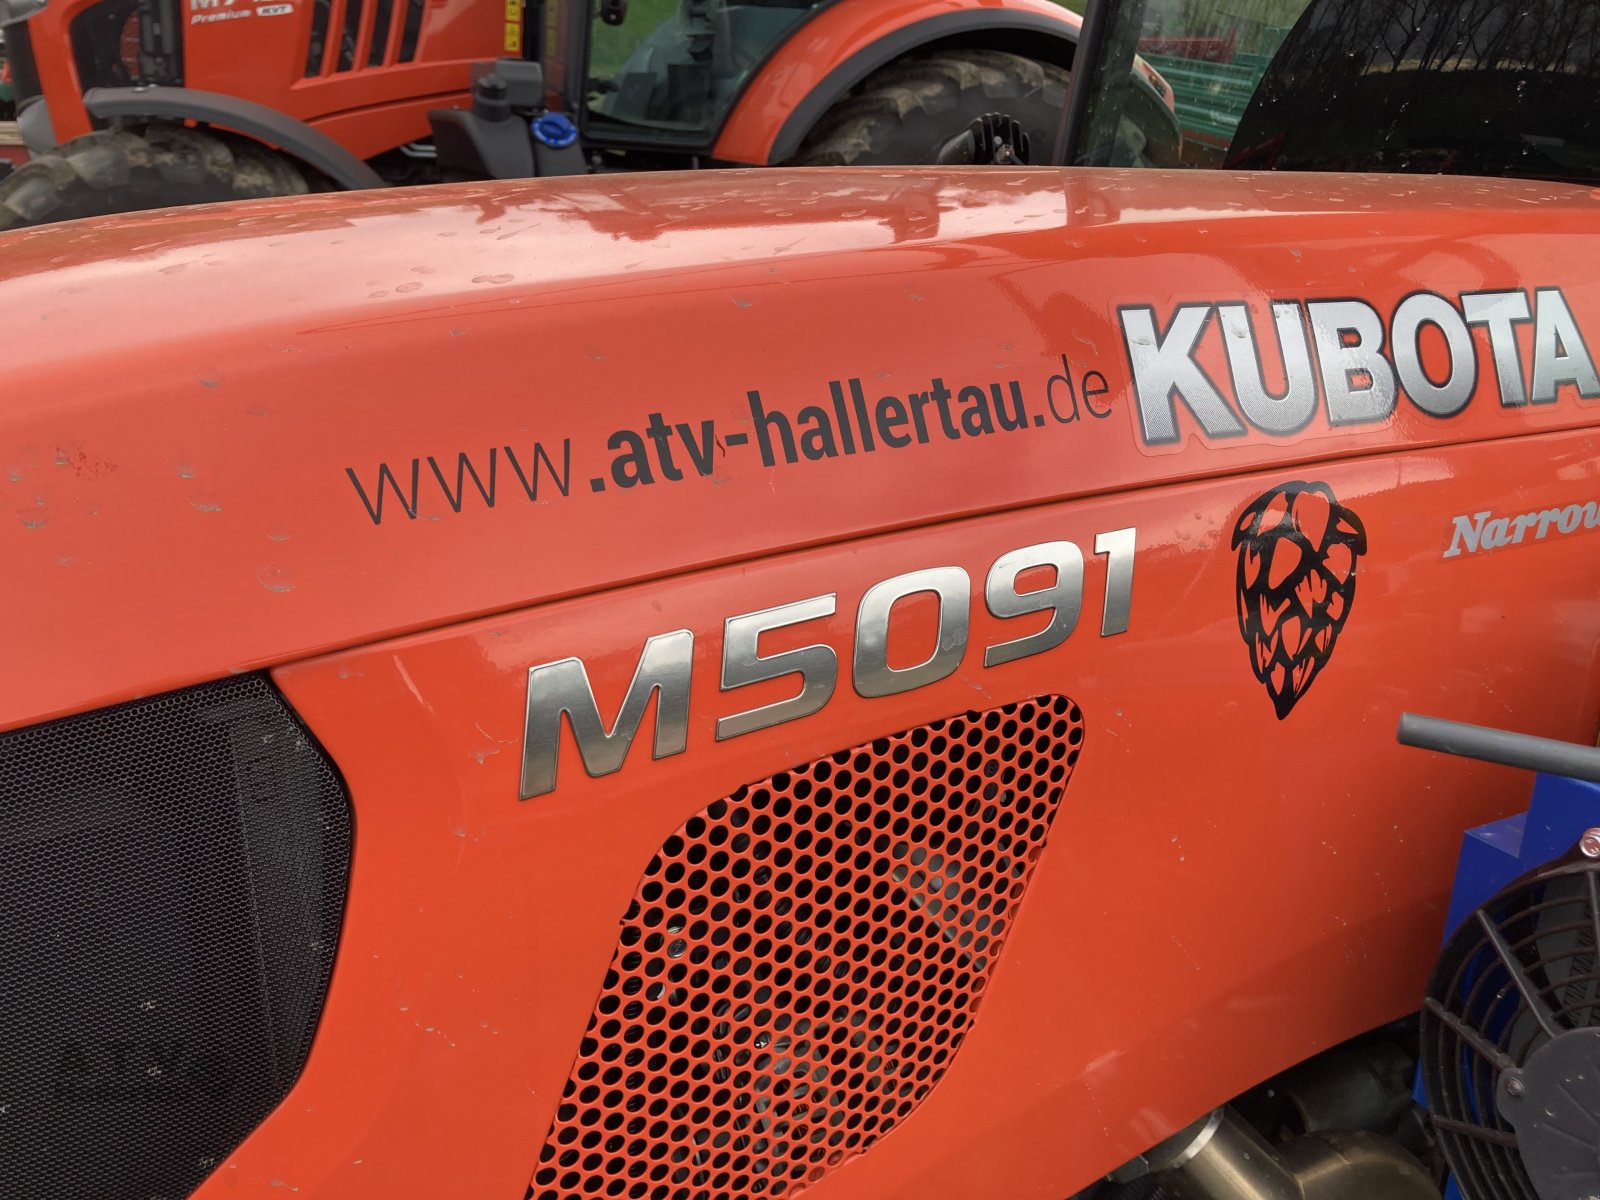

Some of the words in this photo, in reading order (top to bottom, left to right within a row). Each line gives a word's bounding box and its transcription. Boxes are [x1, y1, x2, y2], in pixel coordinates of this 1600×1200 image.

[191, 10, 252, 25] Premium
[344, 354, 1115, 526] www.atv-hallertau.de
[1117, 286, 1600, 446] KUBOTA
[519, 527, 1137, 801] M5091
